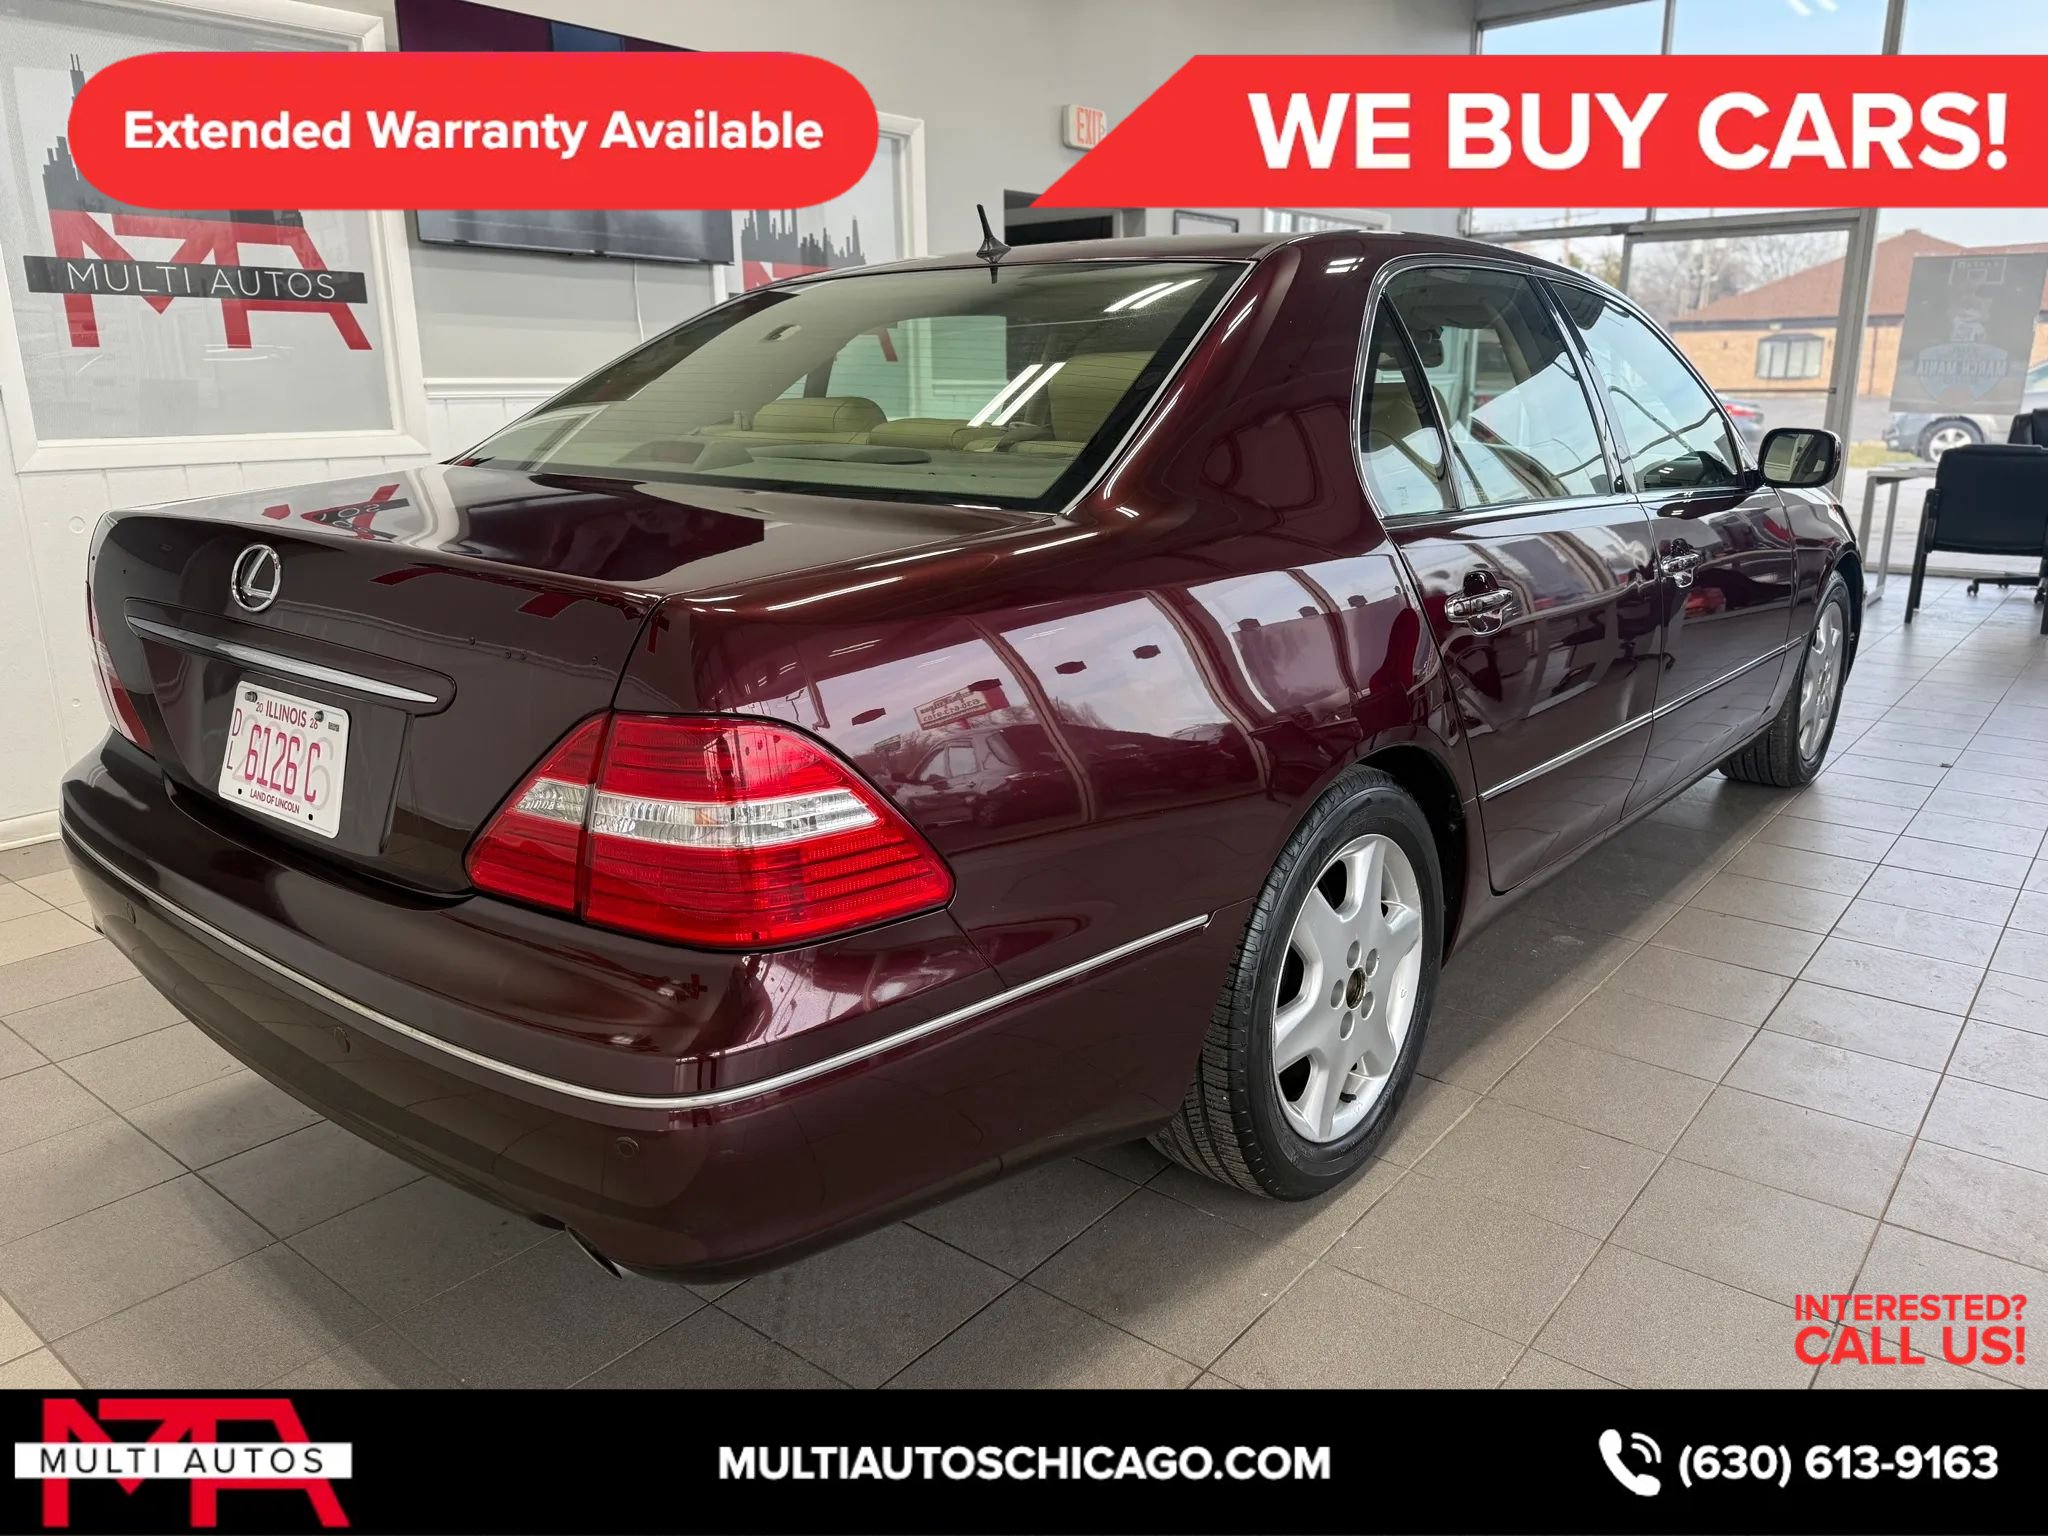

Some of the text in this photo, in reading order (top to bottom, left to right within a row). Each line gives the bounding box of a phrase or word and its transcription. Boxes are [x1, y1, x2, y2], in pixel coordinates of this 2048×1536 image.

[1075, 107, 1103, 145] EXIT
[66, 261, 336, 300] MULTI AUTOS
[255, 702, 263, 713] 20
[265, 700, 307, 728] ILLINOIS
[309, 718, 319, 730] 26
[244, 724, 321, 803] 6126 C
[249, 788, 300, 814] LAND OF LINCOLN
